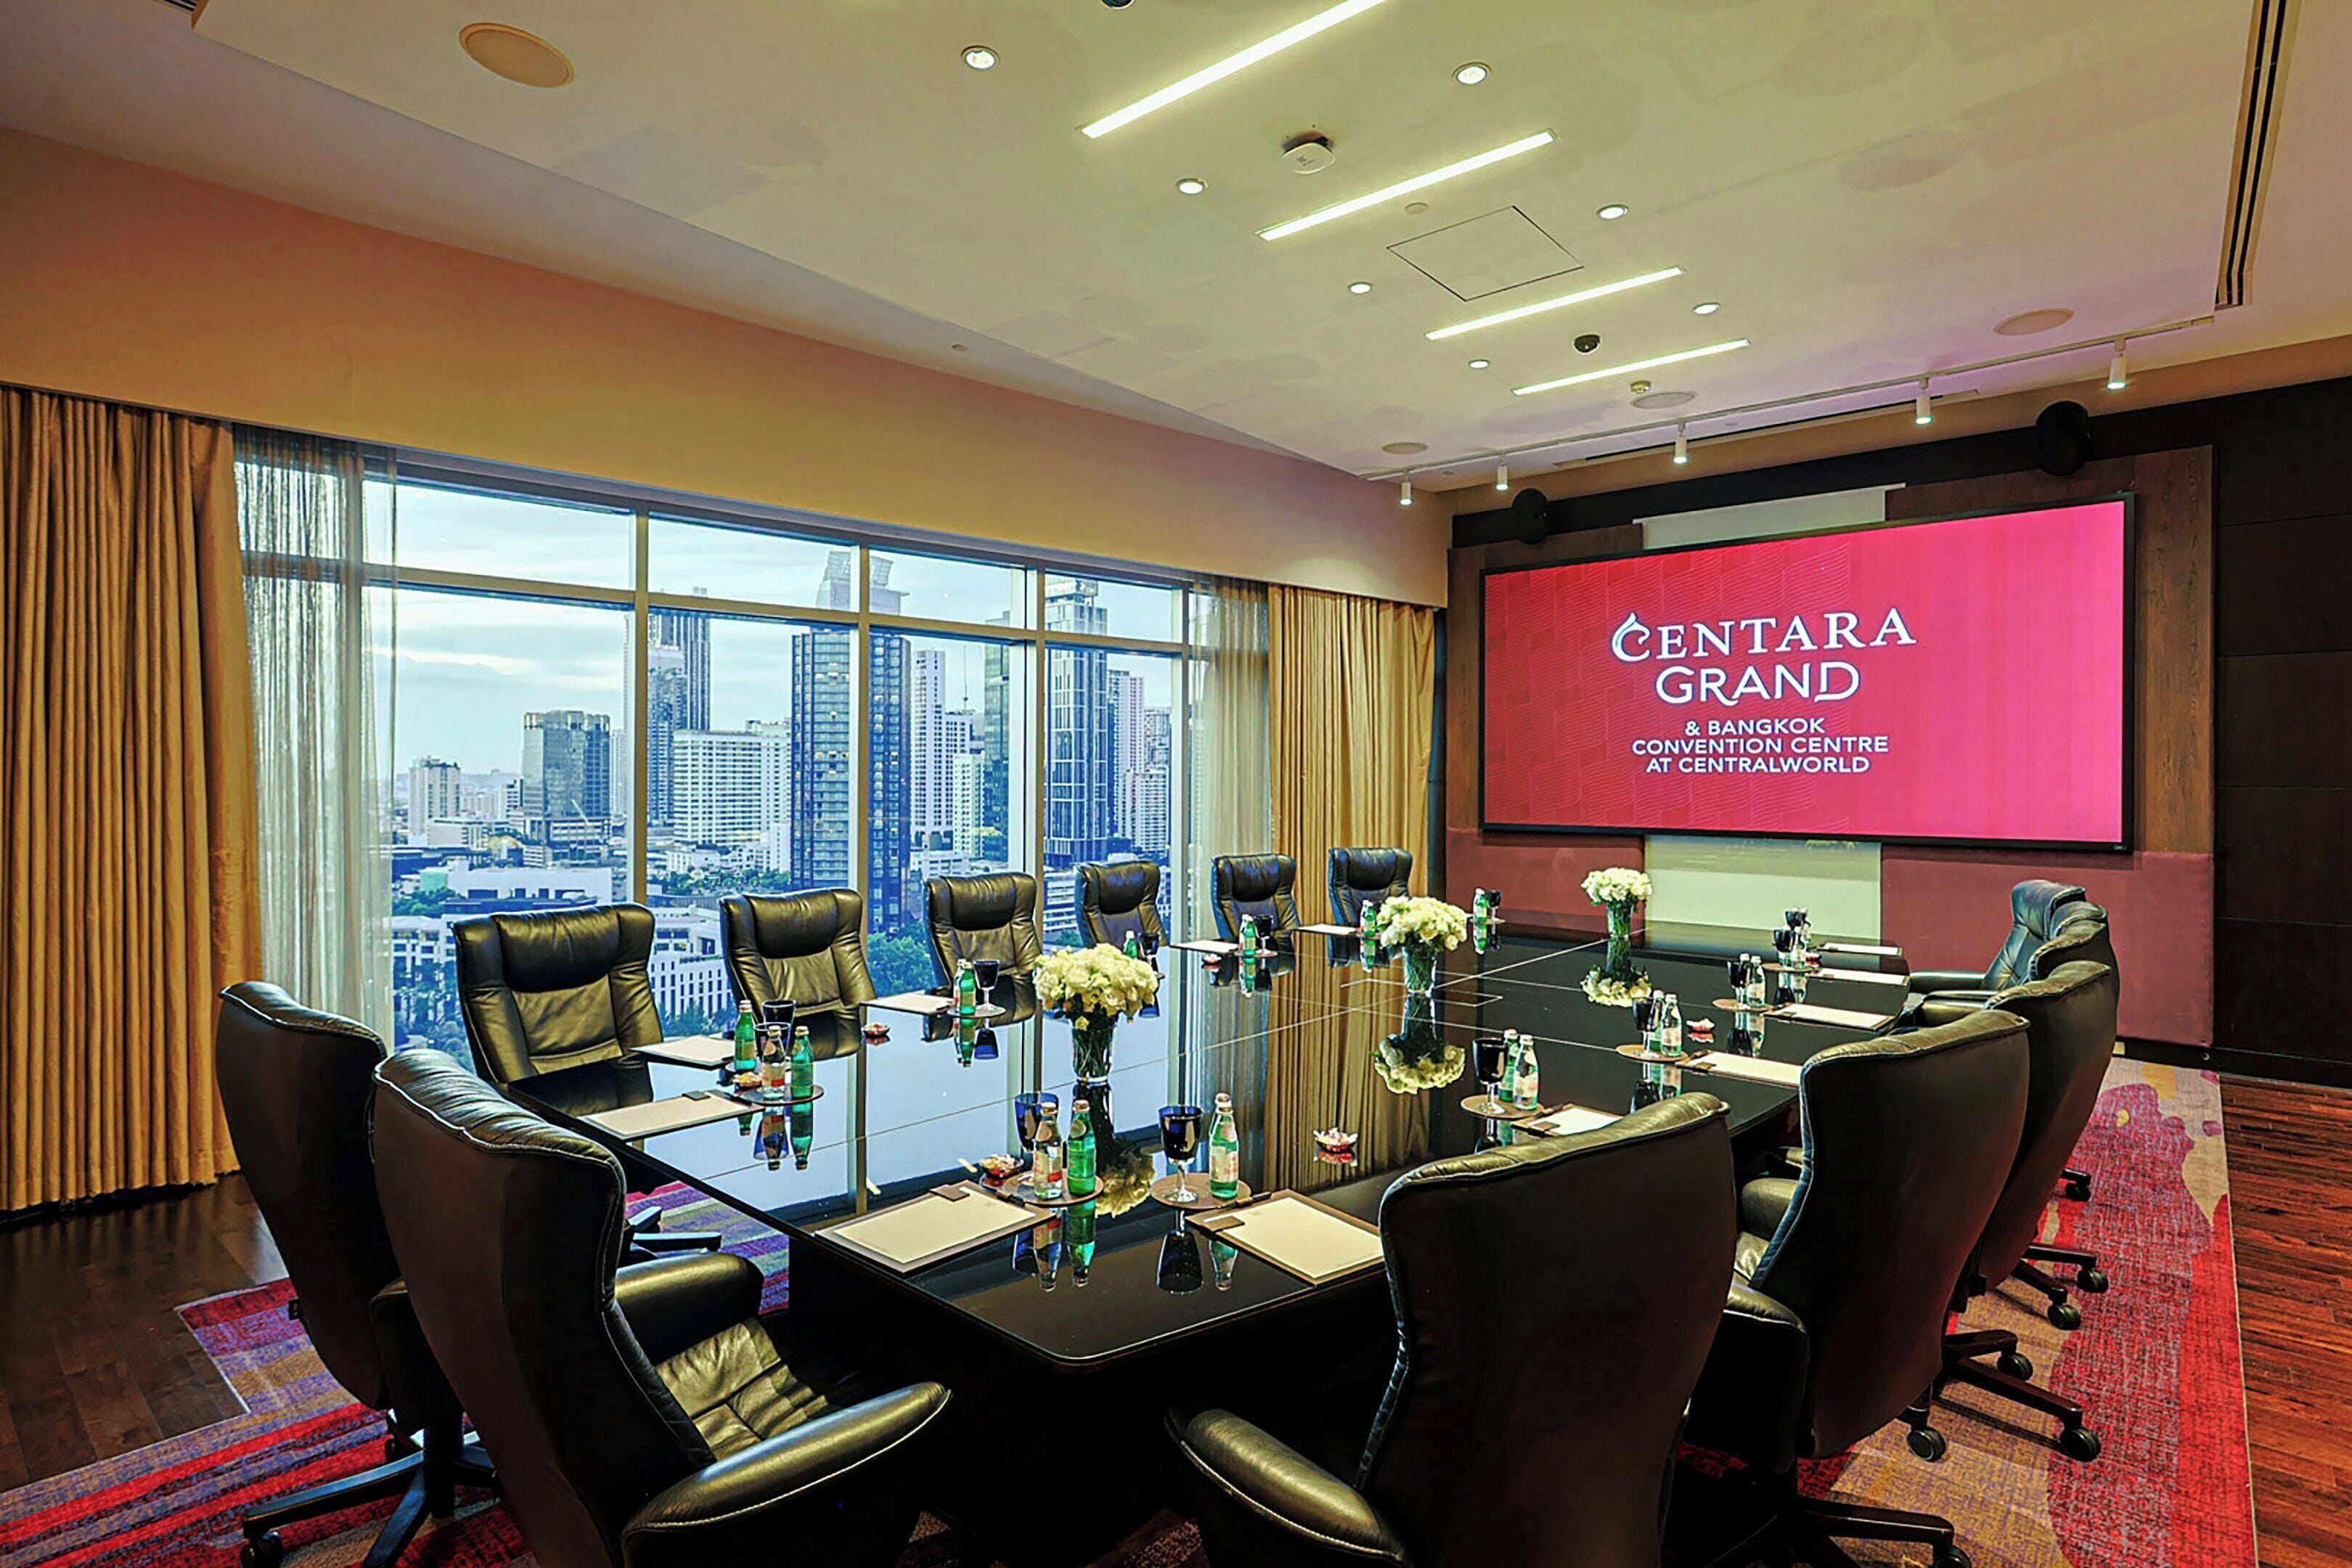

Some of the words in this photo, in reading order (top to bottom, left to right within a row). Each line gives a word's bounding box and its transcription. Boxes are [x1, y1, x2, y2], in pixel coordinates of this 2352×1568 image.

[1612, 608, 1916, 662] CENTARA
[1656, 661, 1859, 706] GRAND
[1685, 721, 1701, 736] &
[1708, 717, 1825, 735] BANGKOK
[1632, 738, 1782, 755] CONVENTION
[1791, 735, 1889, 754] CENTRE
[1646, 757, 1673, 773] AT
[1678, 756, 1869, 773] CENTRALWORLD
